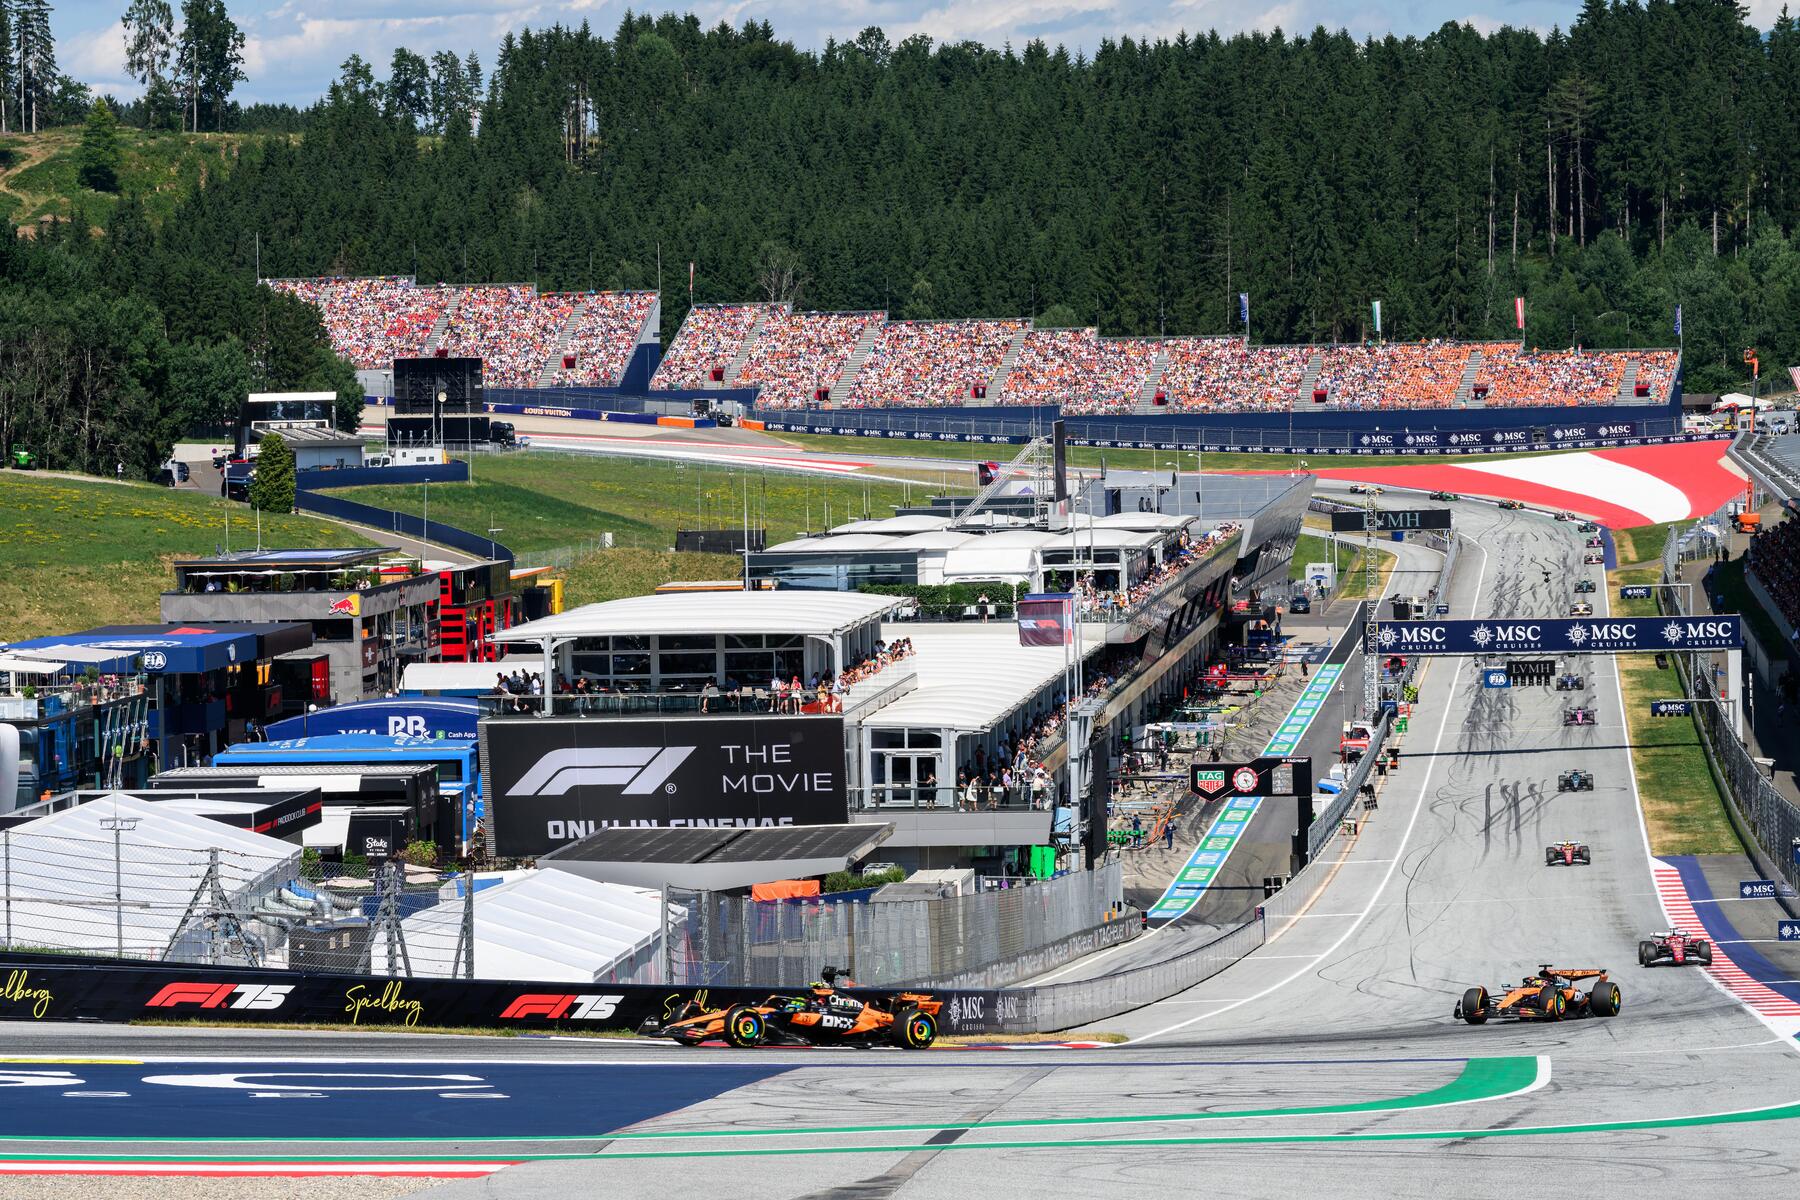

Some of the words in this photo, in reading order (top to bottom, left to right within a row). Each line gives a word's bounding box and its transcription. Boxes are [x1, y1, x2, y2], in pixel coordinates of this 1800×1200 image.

[1504, 432, 1526, 440] MSC
[1564, 428, 1586, 437] MSC
[1609, 426, 1630, 434] MSC
[1401, 626, 1446, 643] MSC
[1496, 625, 1541, 641] MSC
[1591, 624, 1636, 640] MSC
[1686, 622, 1732, 638] MSC
[144, 653, 165, 667] FIA
[1512, 663, 1550, 673] LVMH
[1490, 674, 1506, 684] FIA
[505, 746, 697, 796] F1
[721, 744, 792, 764] THE
[722, 773, 833, 793] MOVIE
[1200, 781, 1223, 791] HEUER
[366, 837, 388, 848] Stake
[230, 985, 296, 1009] 75
[345, 981, 423, 1026] Spielberg
[570, 996, 624, 1019] 75
[962, 996, 984, 1019] MSC
[1005, 996, 1018, 1018] MSC
